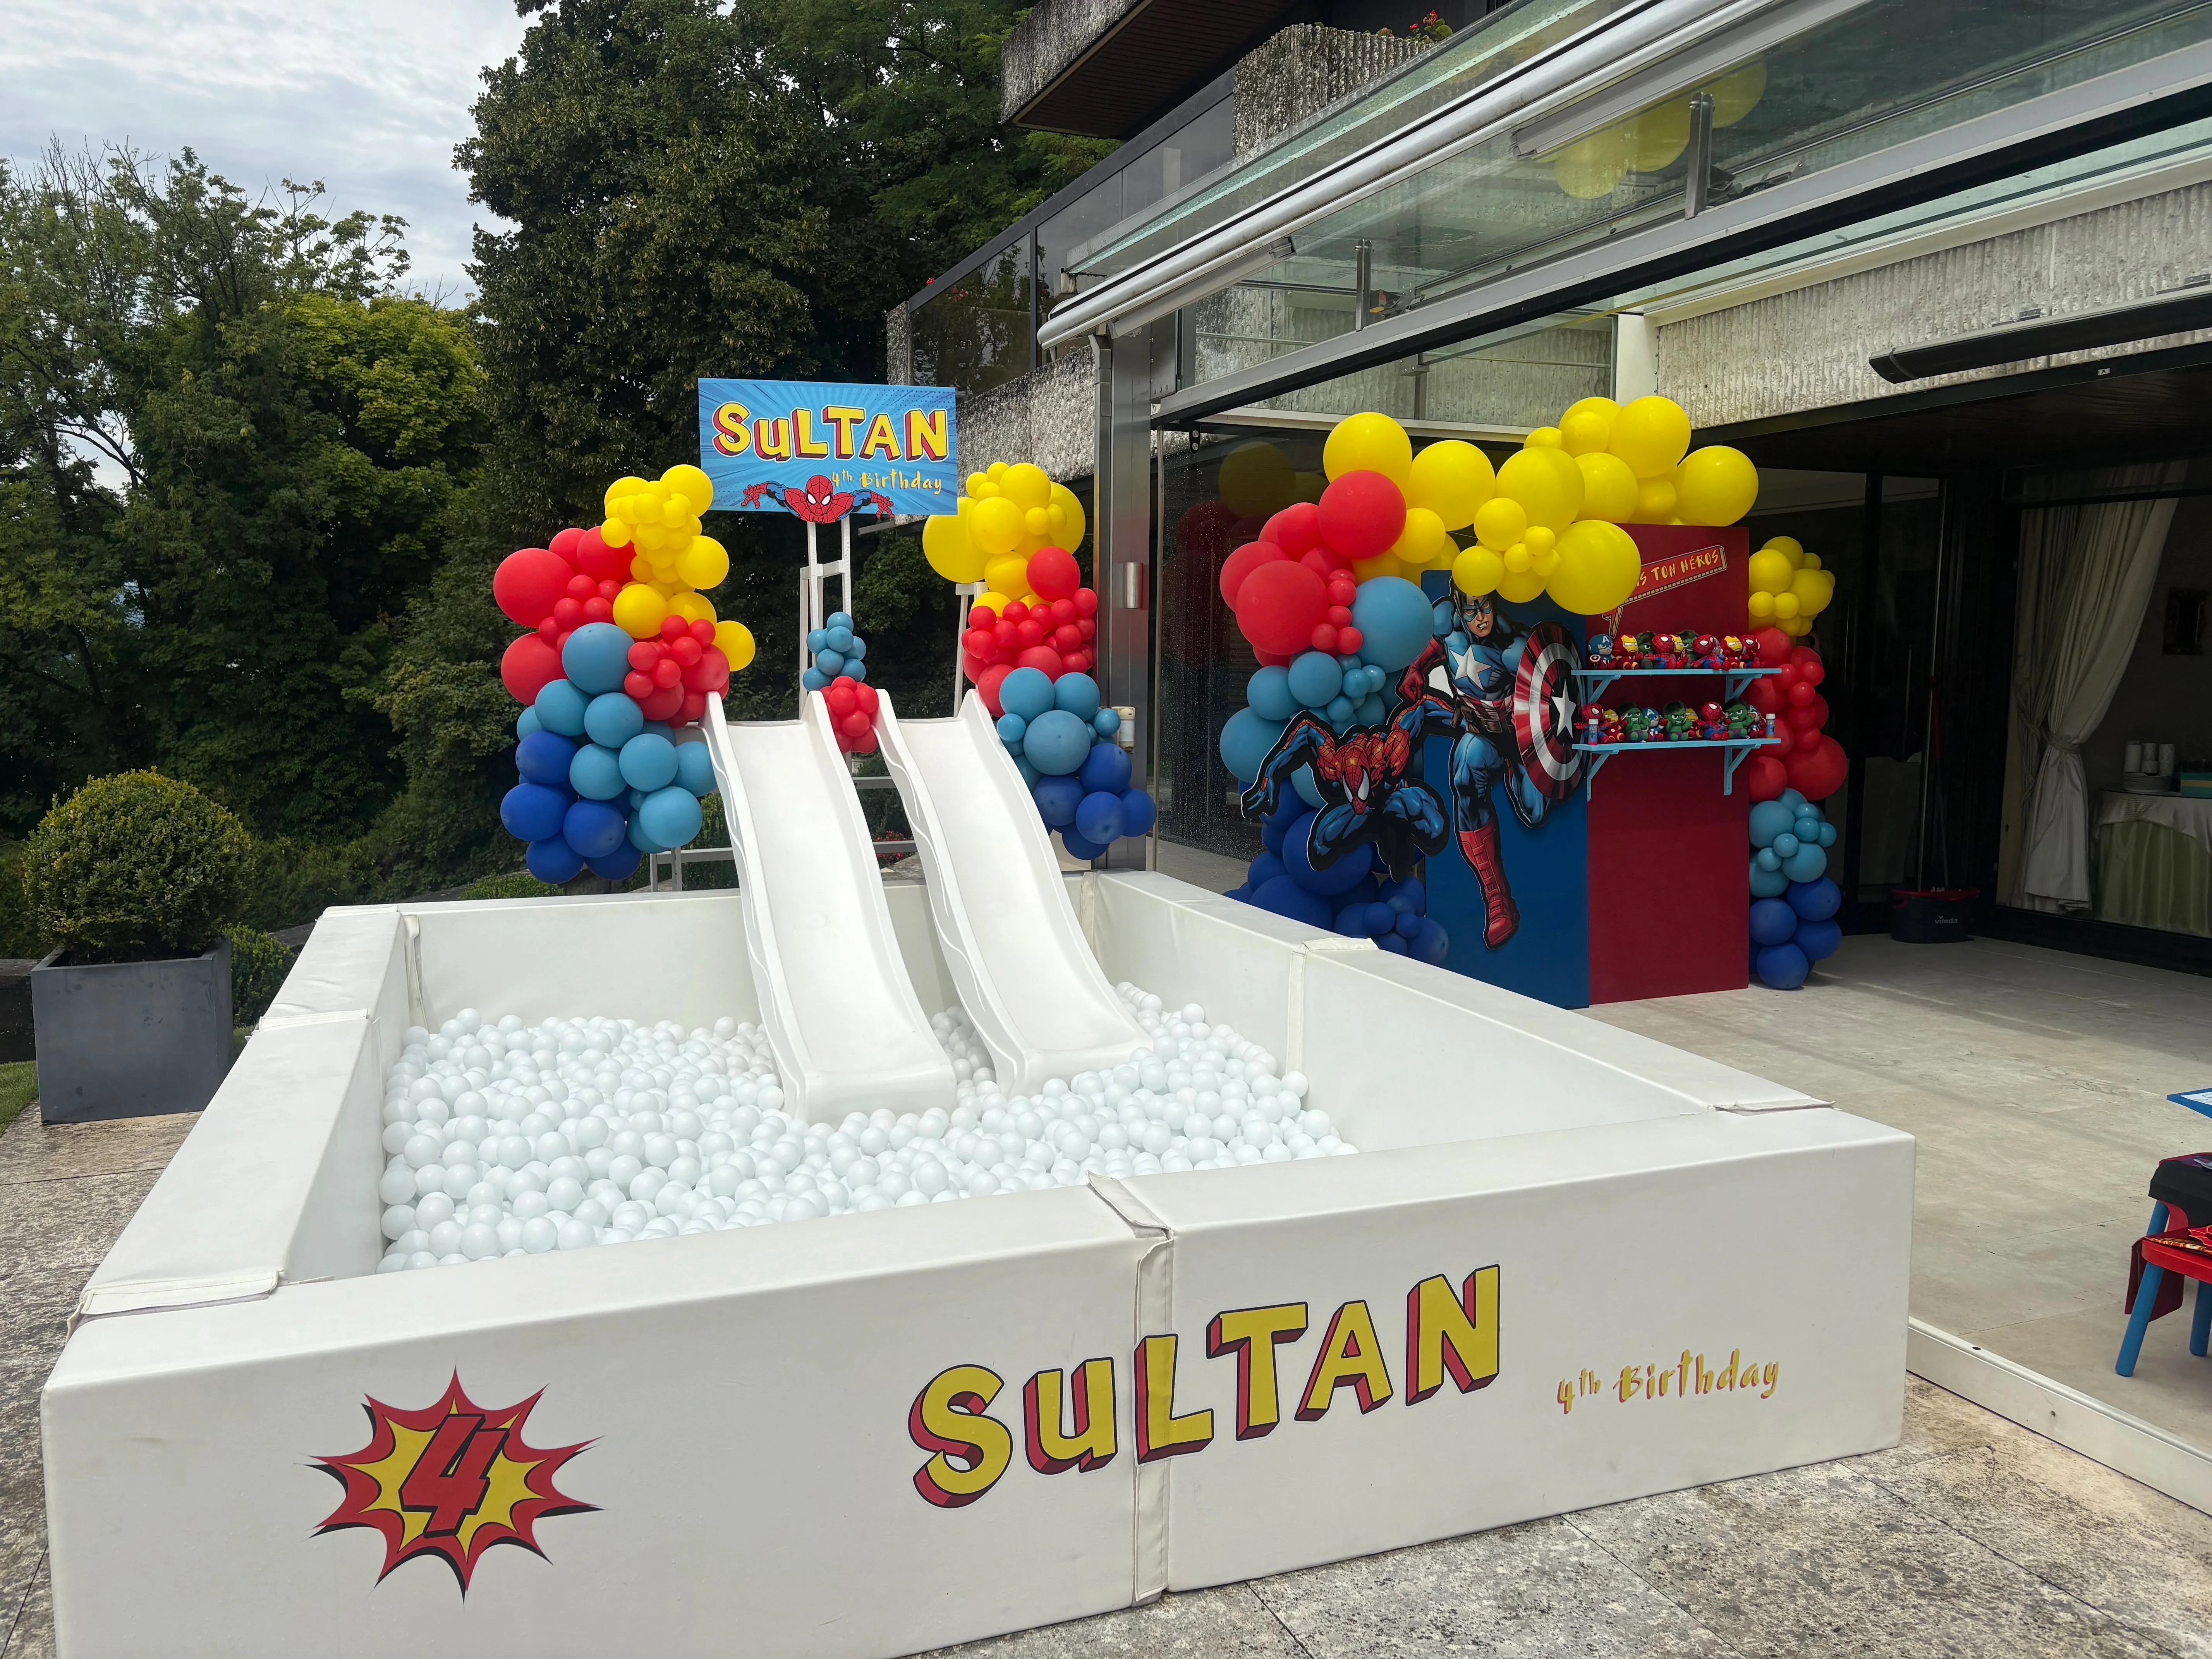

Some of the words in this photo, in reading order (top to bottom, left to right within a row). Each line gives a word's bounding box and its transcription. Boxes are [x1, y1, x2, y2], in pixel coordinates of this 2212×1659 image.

[832, 469, 852, 487] 4th
[859, 468, 941, 495] Birthday
[1651, 563, 1676, 580] TON
[1680, 550, 1719, 573] HÉROS
[1934, 915, 1958, 924] vileda
[1557, 1368, 1601, 1414] 4th
[1613, 1348, 1779, 1403] Birthday
[398, 1413, 510, 1538] 4
